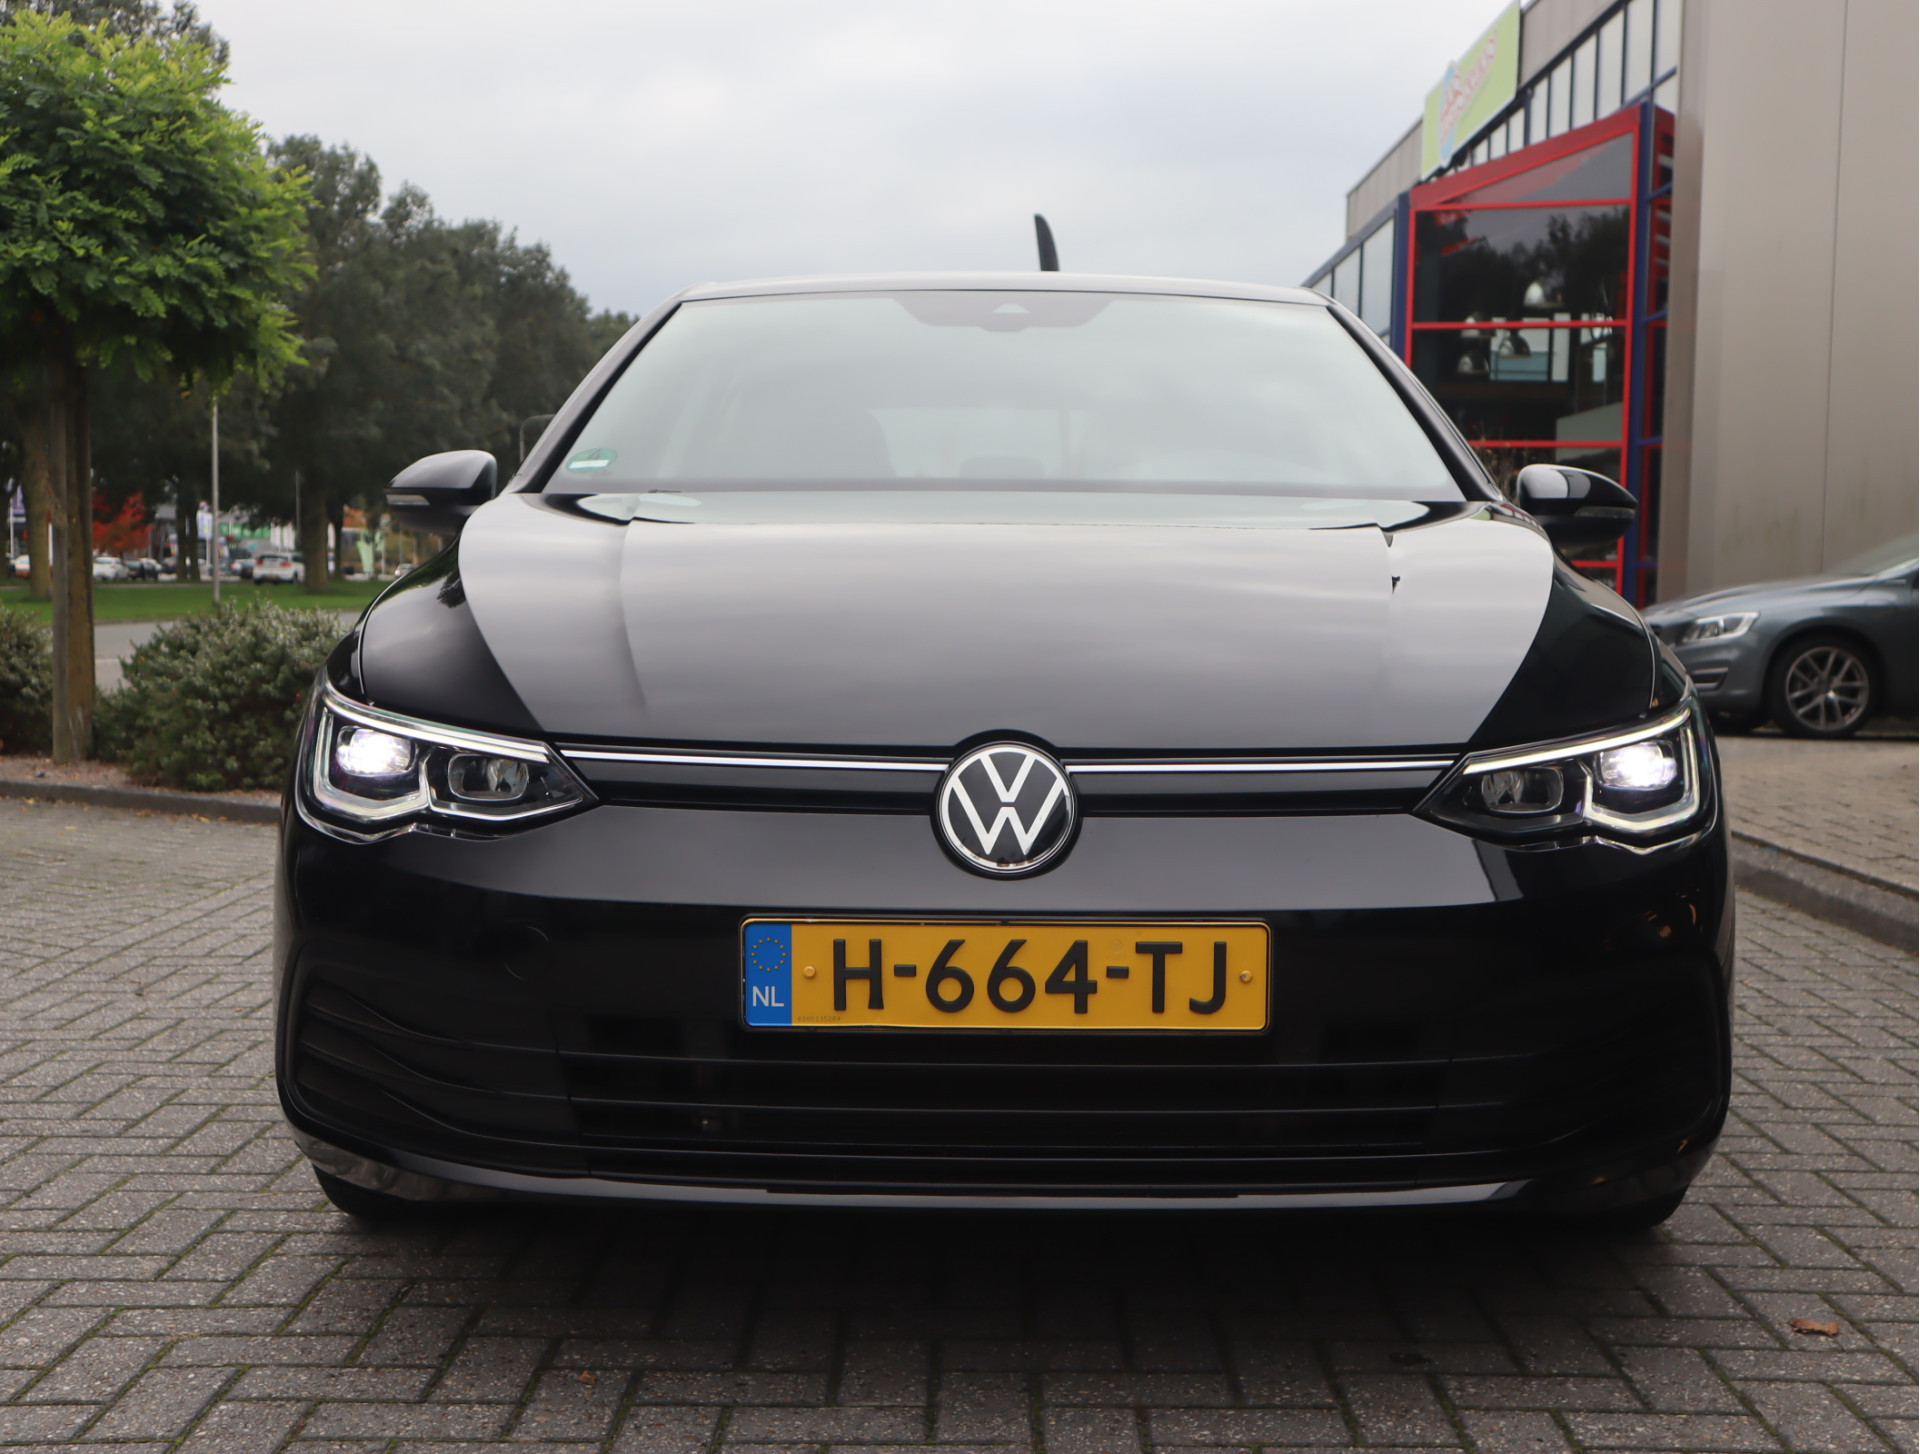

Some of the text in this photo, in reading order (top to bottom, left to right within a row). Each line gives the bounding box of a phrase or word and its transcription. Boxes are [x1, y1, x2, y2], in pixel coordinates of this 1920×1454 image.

[948, 749, 1067, 857] VW
[752, 985, 785, 1007] NL
[832, 938, 1228, 1015] H-664-TJ
